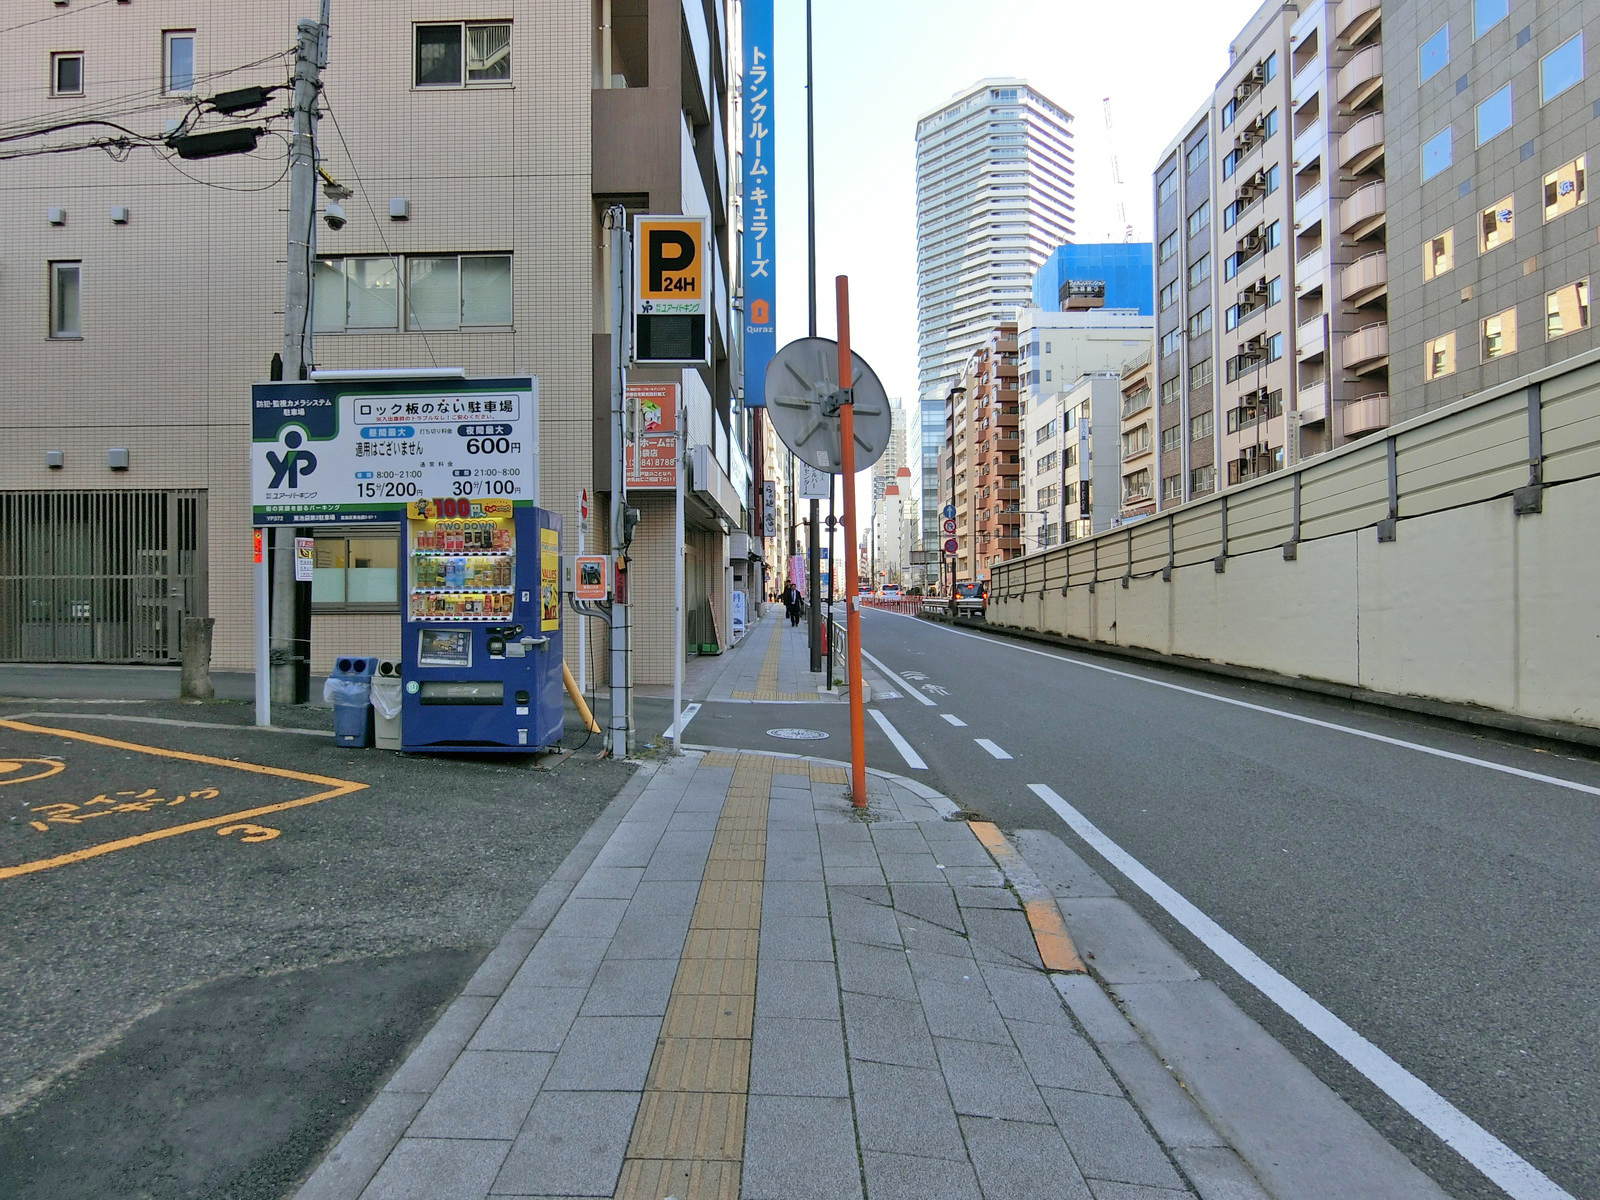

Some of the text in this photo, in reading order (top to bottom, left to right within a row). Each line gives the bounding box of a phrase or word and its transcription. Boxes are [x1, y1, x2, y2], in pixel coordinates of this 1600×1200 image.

[749, 46, 769, 278] トランクルーム・キュラーズ
[649, 230, 696, 292] P
[663, 277, 695, 292] 24H
[746, 326, 774, 334] Quraz
[256, 400, 332, 408] 防犯・監視カメラシステム
[360, 400, 513, 415] ロック板のない駐車場
[283, 408, 305, 416] 駐車場
[369, 428, 406, 437] 昼間最大
[466, 425, 504, 435] 夜間最大
[355, 440, 424, 458] 適用はございません
[466, 437, 521, 454] 600円
[357, 482, 423, 497] 15分/200円
[452, 480, 521, 496] 30分/100円
[217, 824, 282, 843] 3
